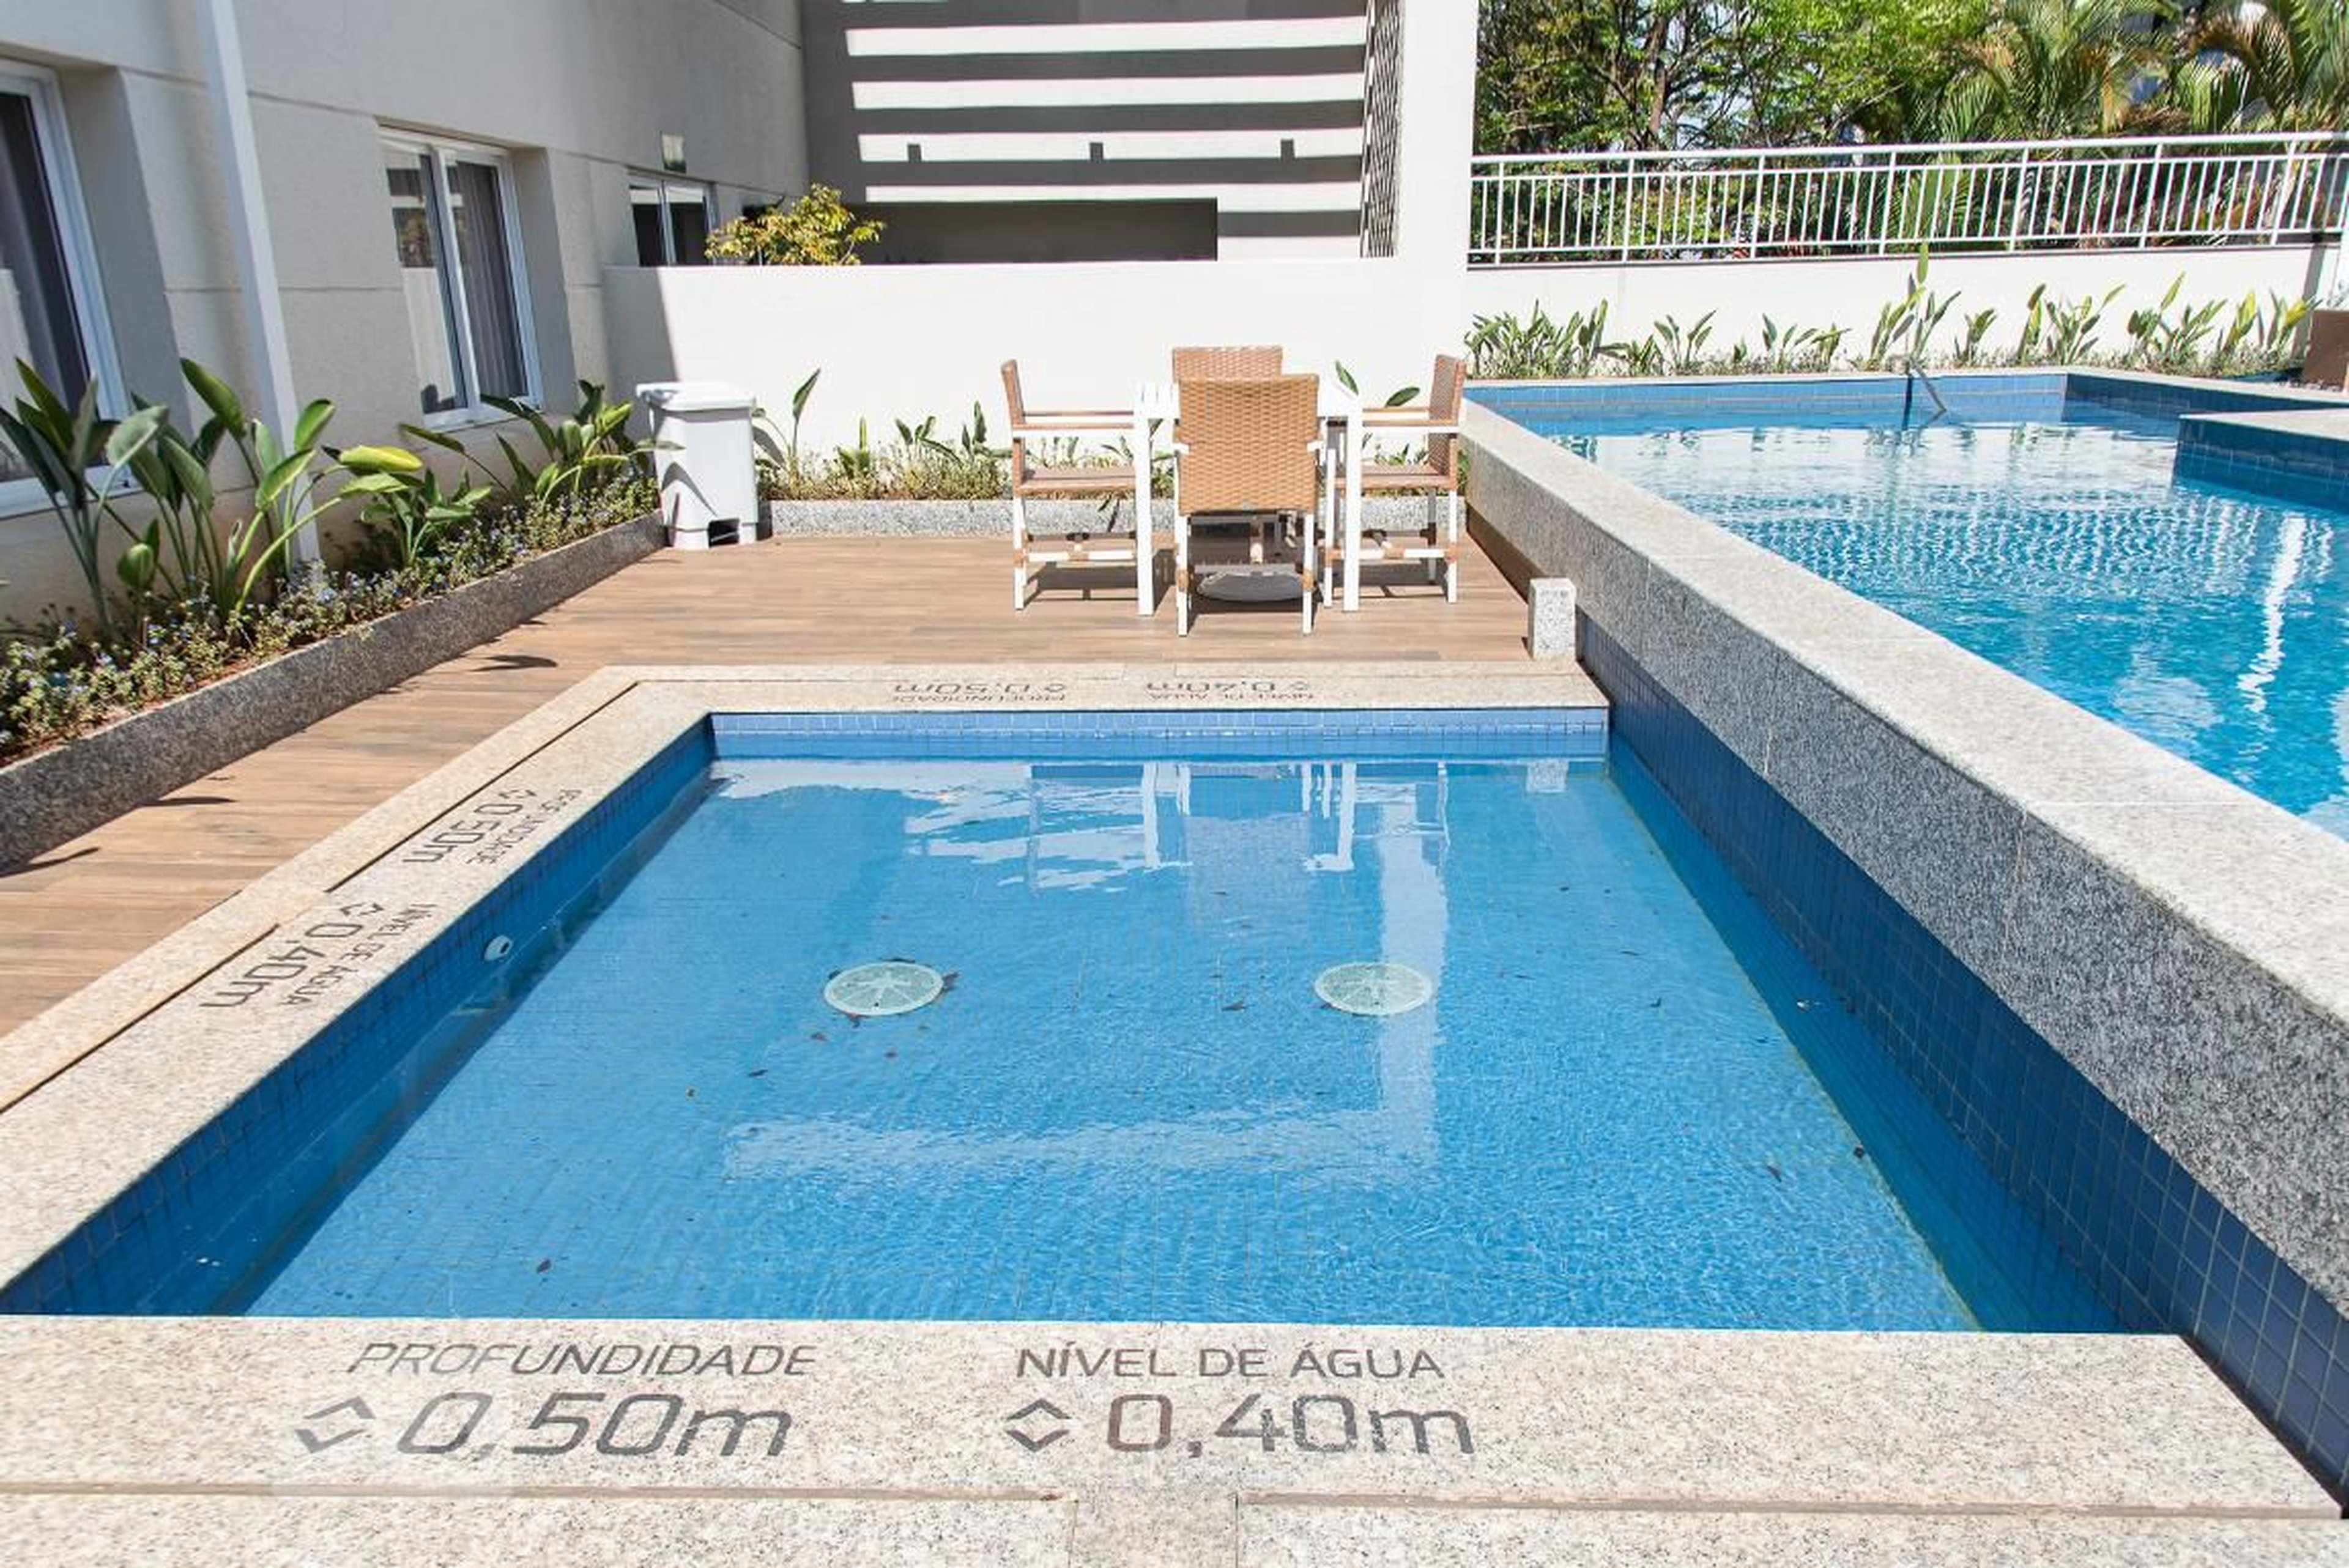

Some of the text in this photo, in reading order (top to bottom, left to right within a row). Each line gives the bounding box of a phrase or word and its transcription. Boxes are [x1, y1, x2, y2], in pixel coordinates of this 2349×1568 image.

[401, 803, 524, 863] 050m
[199, 922, 365, 1007] 0,40m
[346, 1342, 817, 1375] PROFUNDIDADE
[1015, 1341, 1445, 1378] NÍVEL DE ÁGUA
[395, 1391, 794, 1460] 0,50m
[1107, 1393, 1475, 1459] 0,40m
